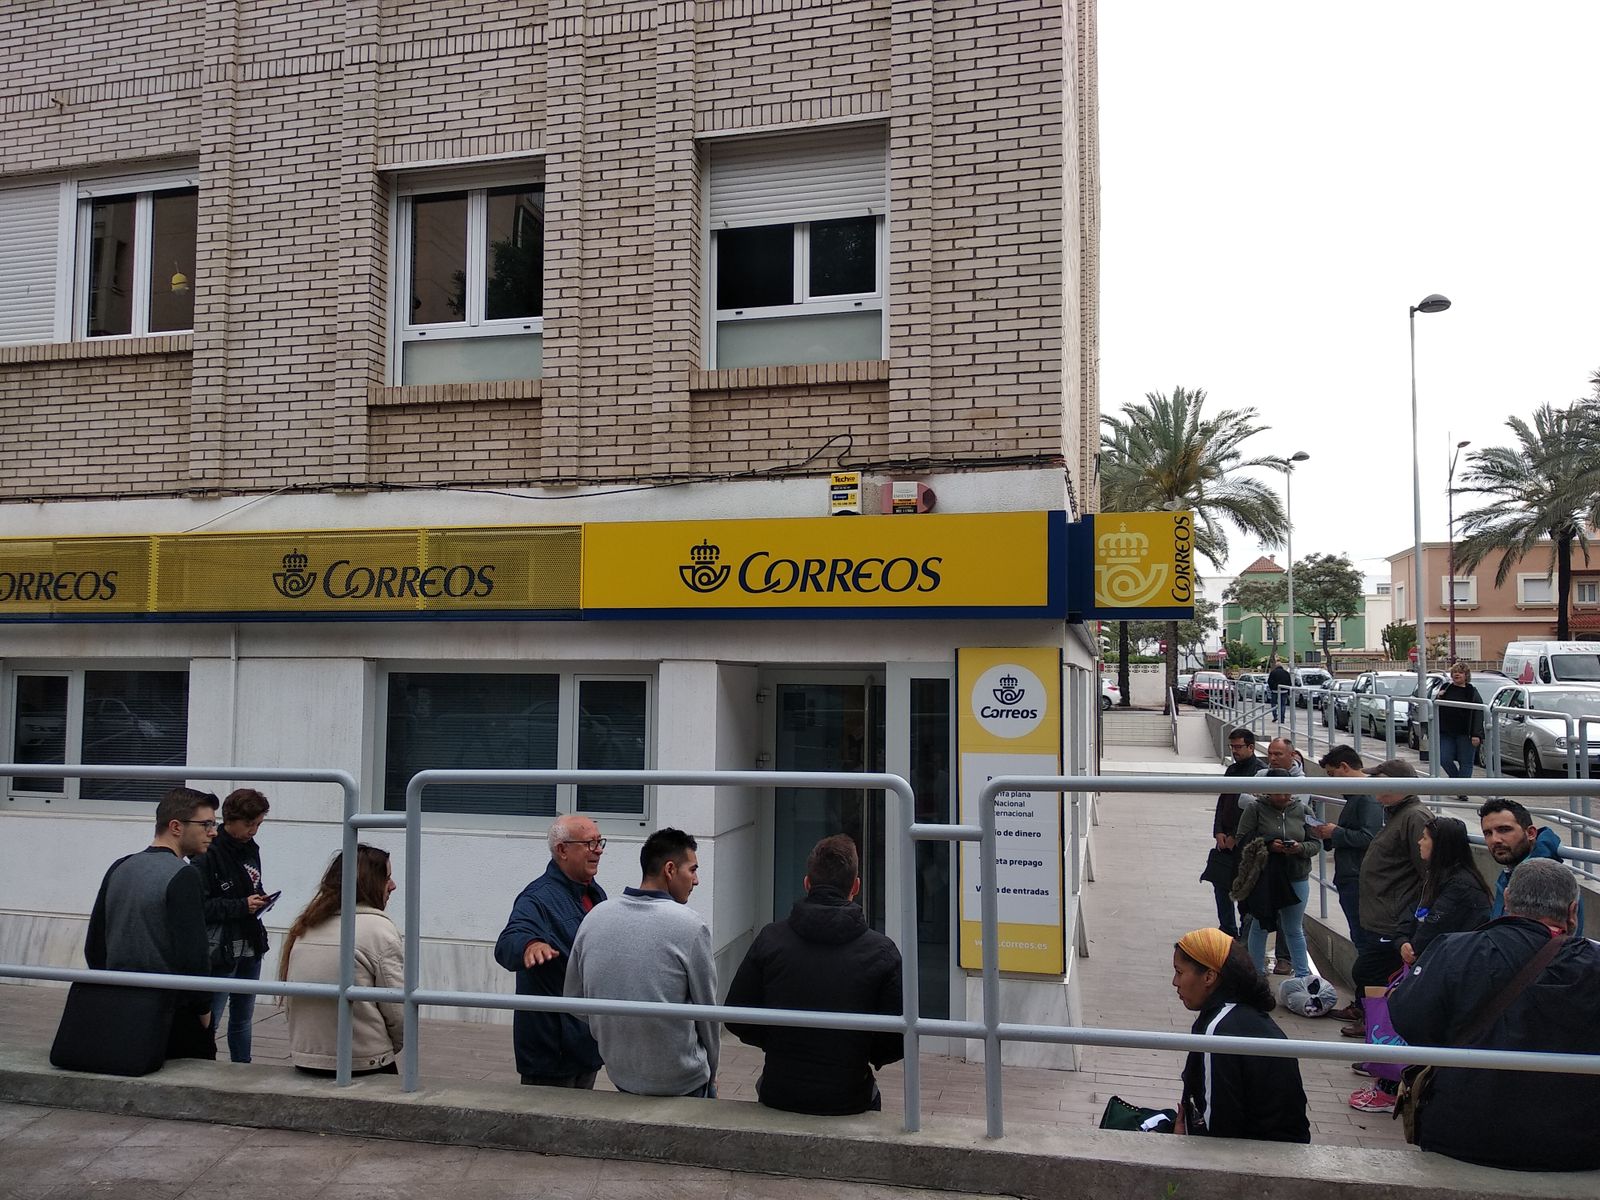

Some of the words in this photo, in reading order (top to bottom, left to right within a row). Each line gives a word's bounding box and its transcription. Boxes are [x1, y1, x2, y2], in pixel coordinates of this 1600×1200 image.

[1171, 515, 1191, 603] CORREOS
[738, 551, 943, 594] CORREOS
[323, 560, 496, 598] CORREOS
[0, 571, 118, 600] ORREOS
[981, 706, 1038, 719] Correos
[1011, 790, 1031, 798] plana
[994, 810, 1034, 818] ernacional
[1003, 829, 1013, 837] de
[1015, 829, 1041, 838] dinero
[1009, 859, 1043, 868] prepago
[1001, 886, 1012, 894] de
[1013, 887, 1050, 896] entradas
[975, 939, 1048, 950] w.correos.es
